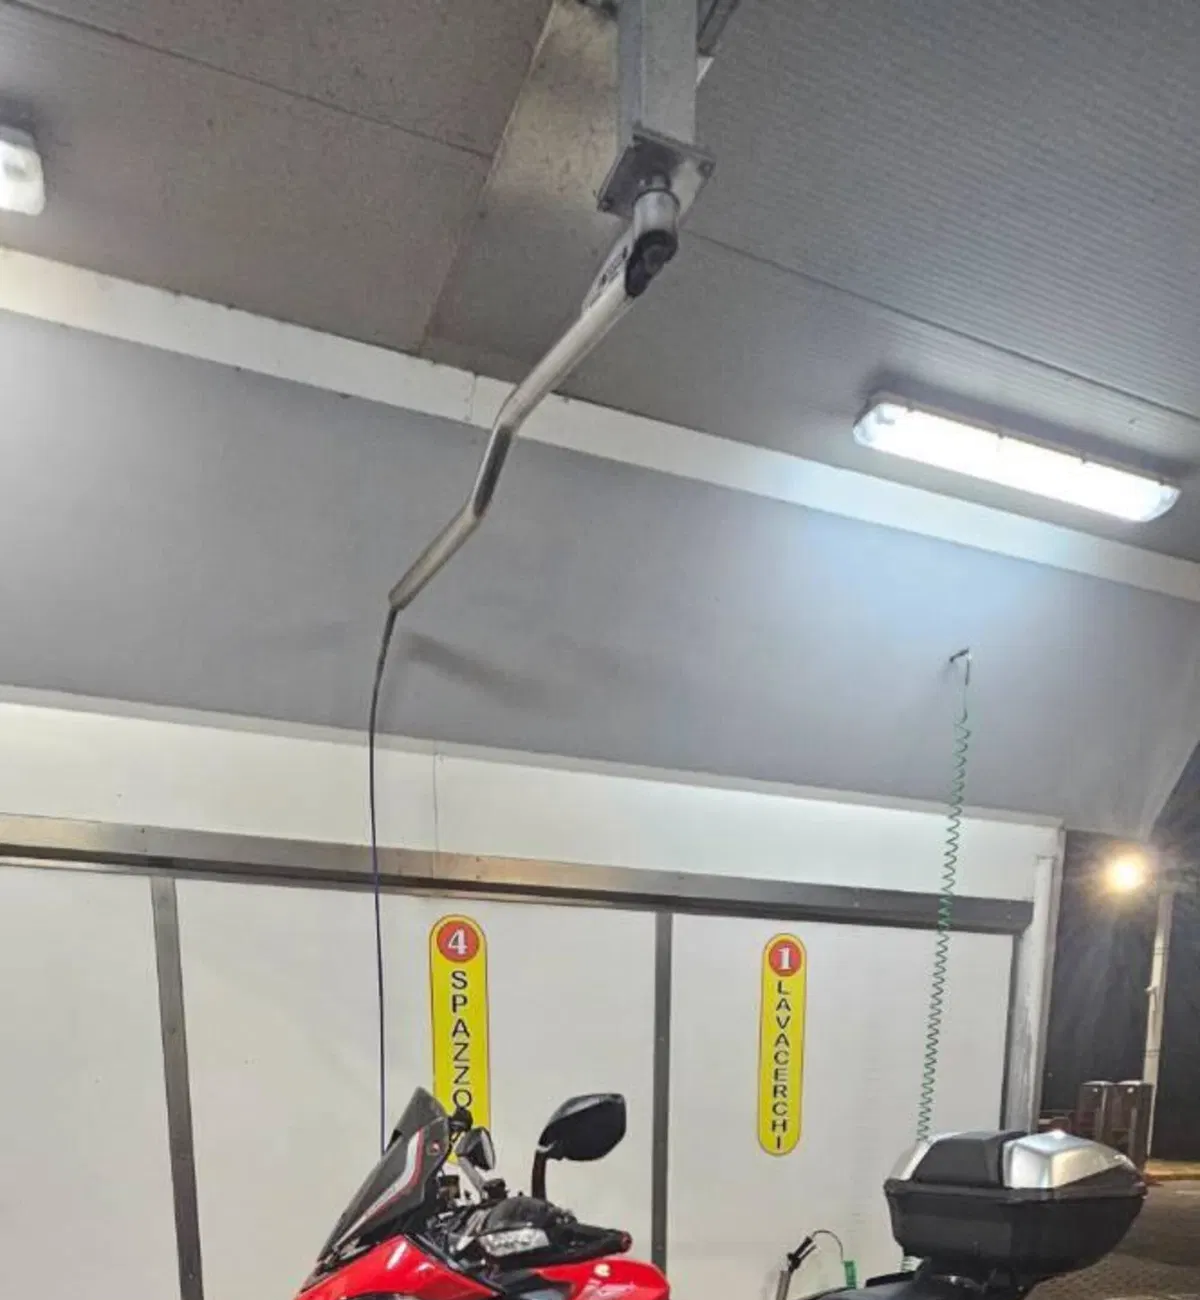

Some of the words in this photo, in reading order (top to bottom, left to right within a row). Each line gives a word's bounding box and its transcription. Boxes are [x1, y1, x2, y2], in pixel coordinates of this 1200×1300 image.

[448, 928, 468, 955] 4
[778, 947, 792, 970] 1
[451, 970, 473, 1109] SPAZZO
[772, 980, 792, 1149] LAVACERCHI
